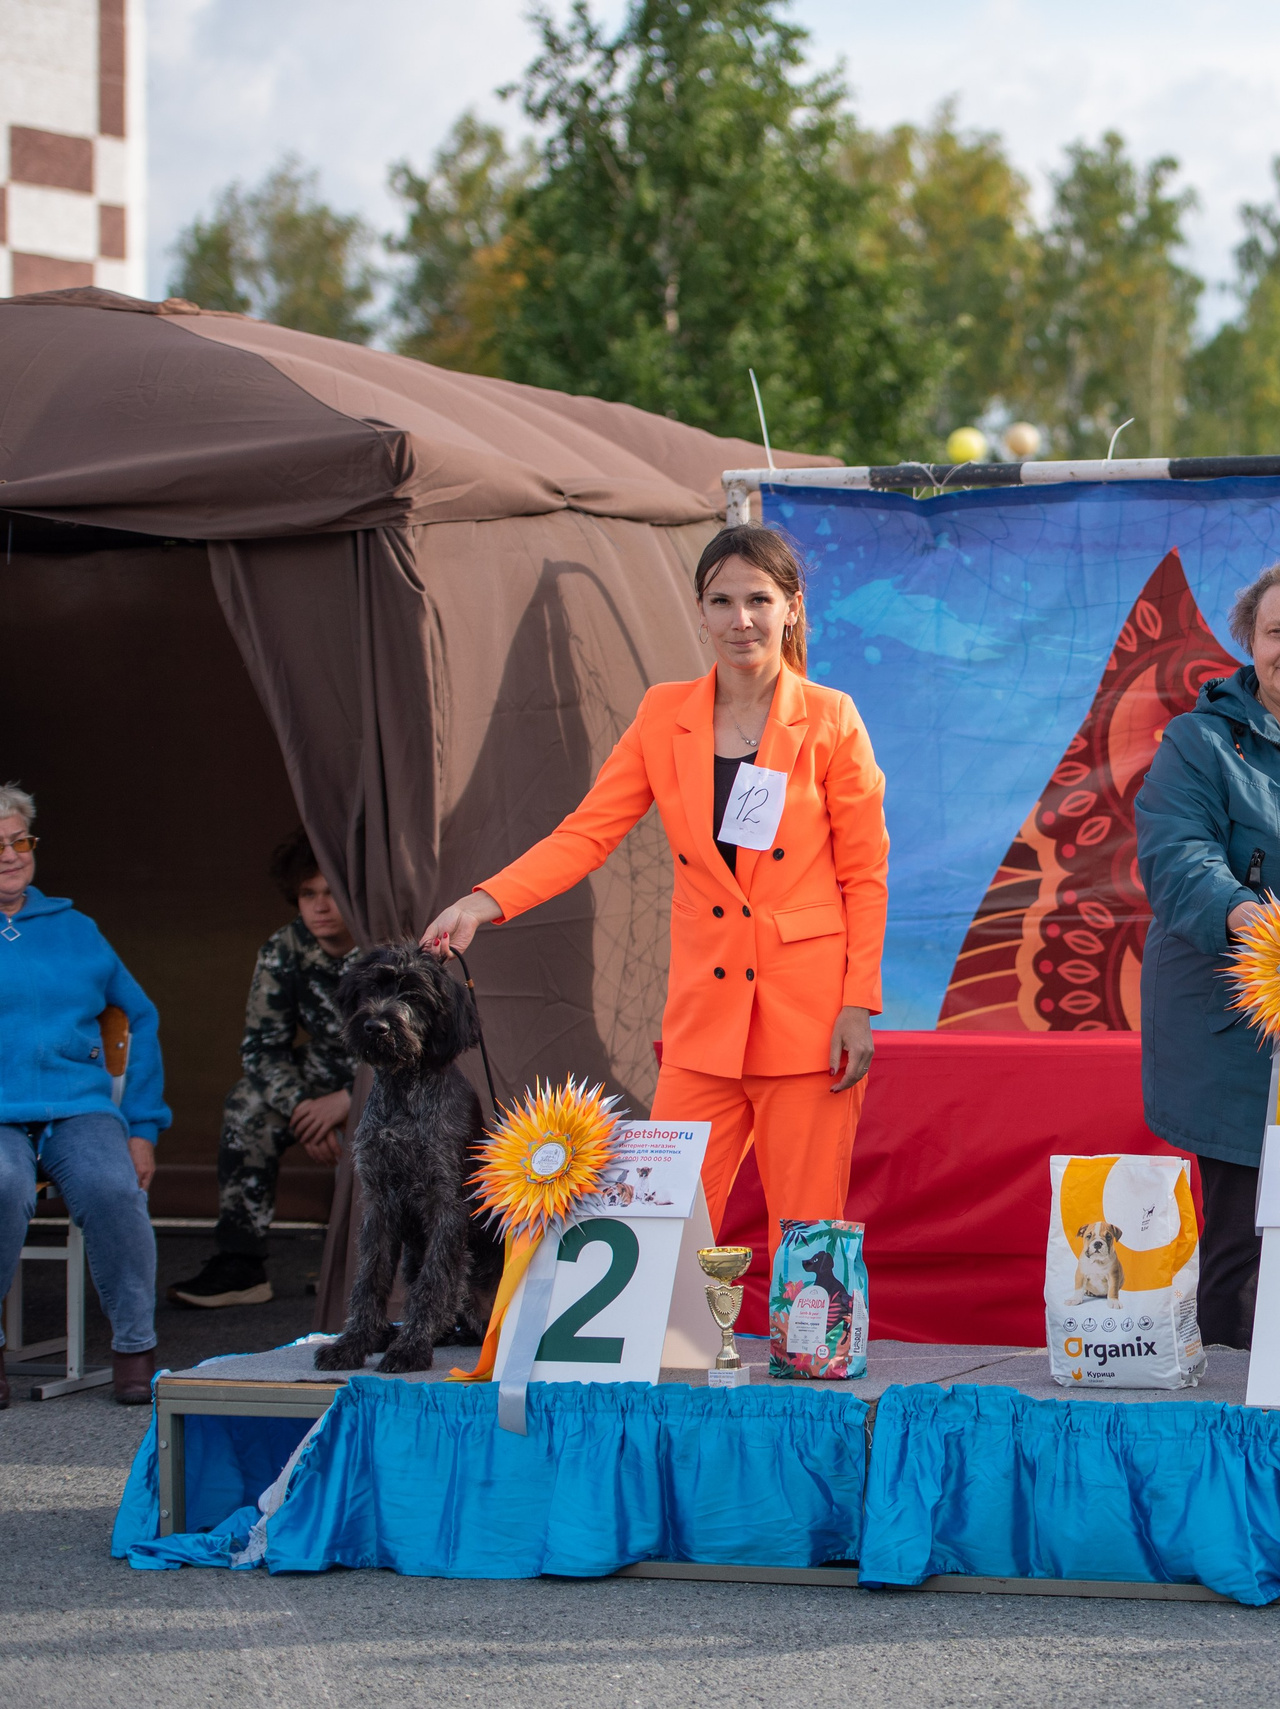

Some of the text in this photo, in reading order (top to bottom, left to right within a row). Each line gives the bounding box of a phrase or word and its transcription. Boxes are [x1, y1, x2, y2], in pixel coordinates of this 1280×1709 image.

[737, 786, 769, 824] 12
[624, 1128, 694, 1142] petshopru
[534, 1218, 640, 1364] 2
[1064, 1336, 1158, 1367] Organix
